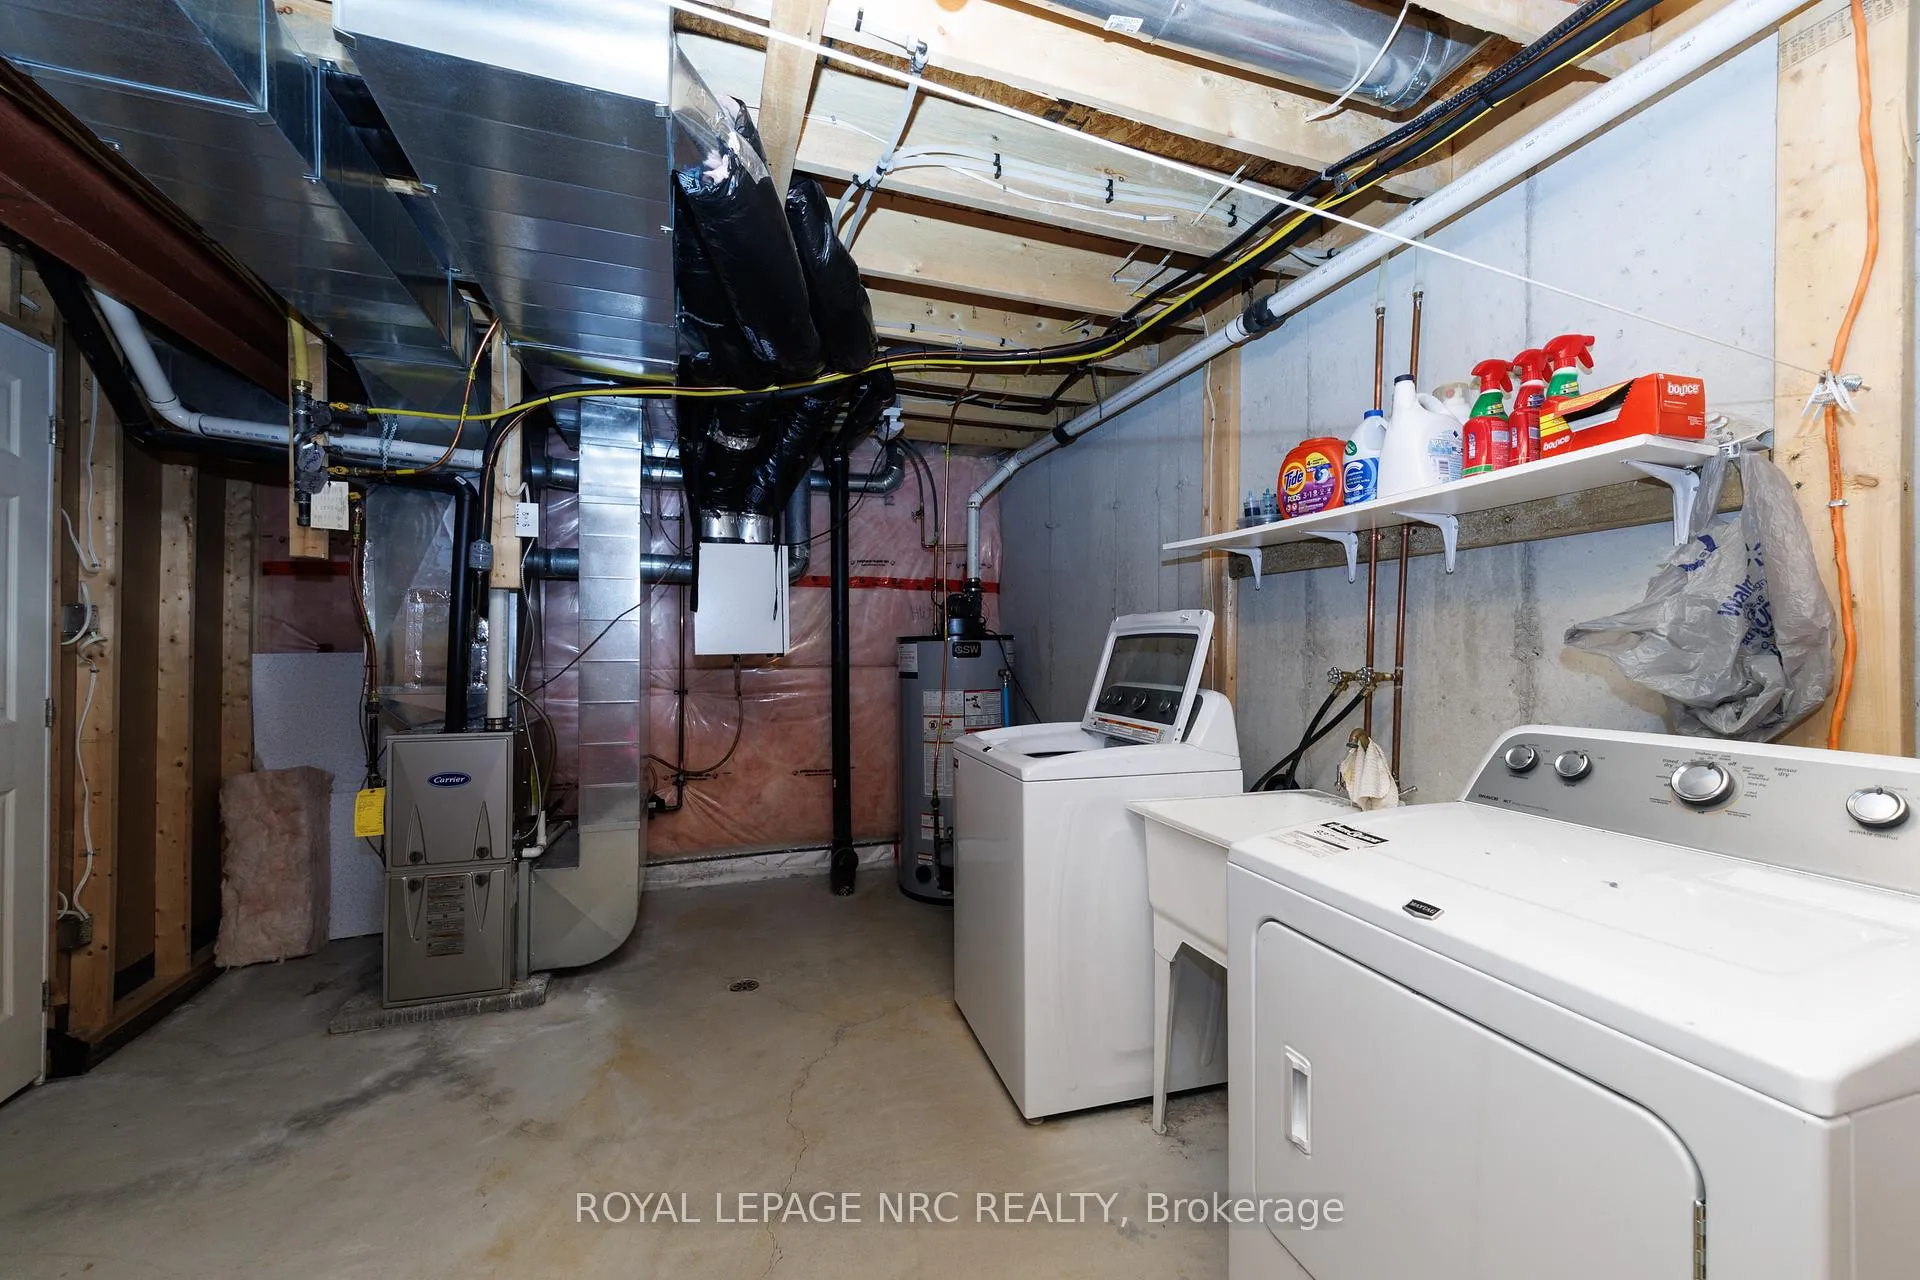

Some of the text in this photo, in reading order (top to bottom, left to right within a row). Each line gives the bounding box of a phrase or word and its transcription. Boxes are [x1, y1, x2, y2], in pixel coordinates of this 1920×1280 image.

[1667, 381, 1700, 397] bounce
[1543, 435, 1570, 451] bounce
[1284, 470, 1304, 491] Tide
[1287, 493, 1301, 503] PODS
[1774, 766, 1798, 774] sensor
[433, 776, 466, 784] Carrier
[1848, 829, 1899, 841] wrinkle control
